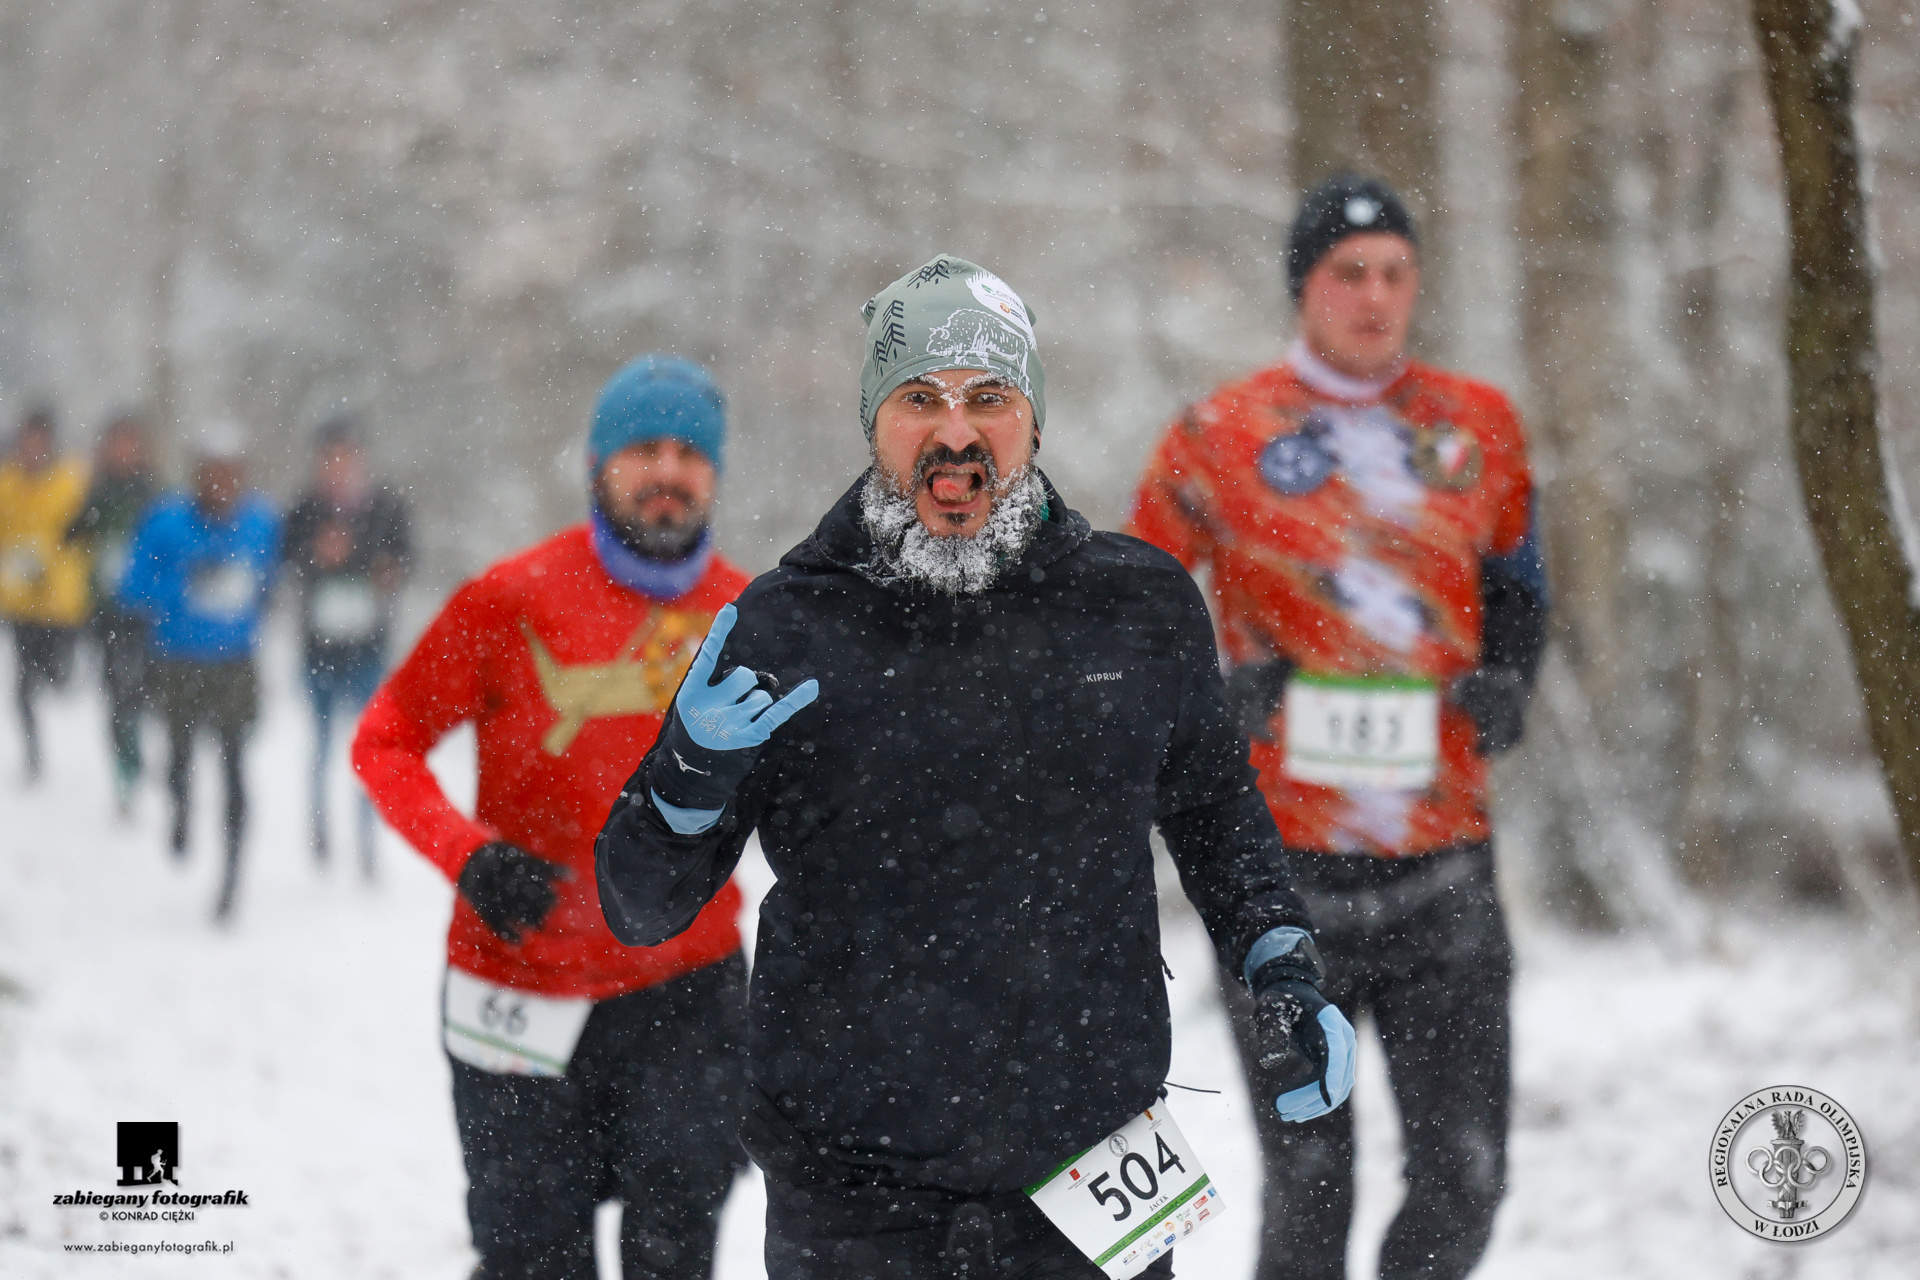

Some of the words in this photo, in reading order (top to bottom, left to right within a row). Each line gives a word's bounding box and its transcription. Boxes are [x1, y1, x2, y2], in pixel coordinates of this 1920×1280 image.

[1086, 671, 1123, 682] KIPRUN
[1087, 1131, 1186, 1222] 504
[1149, 1194, 1170, 1212] JACEK
